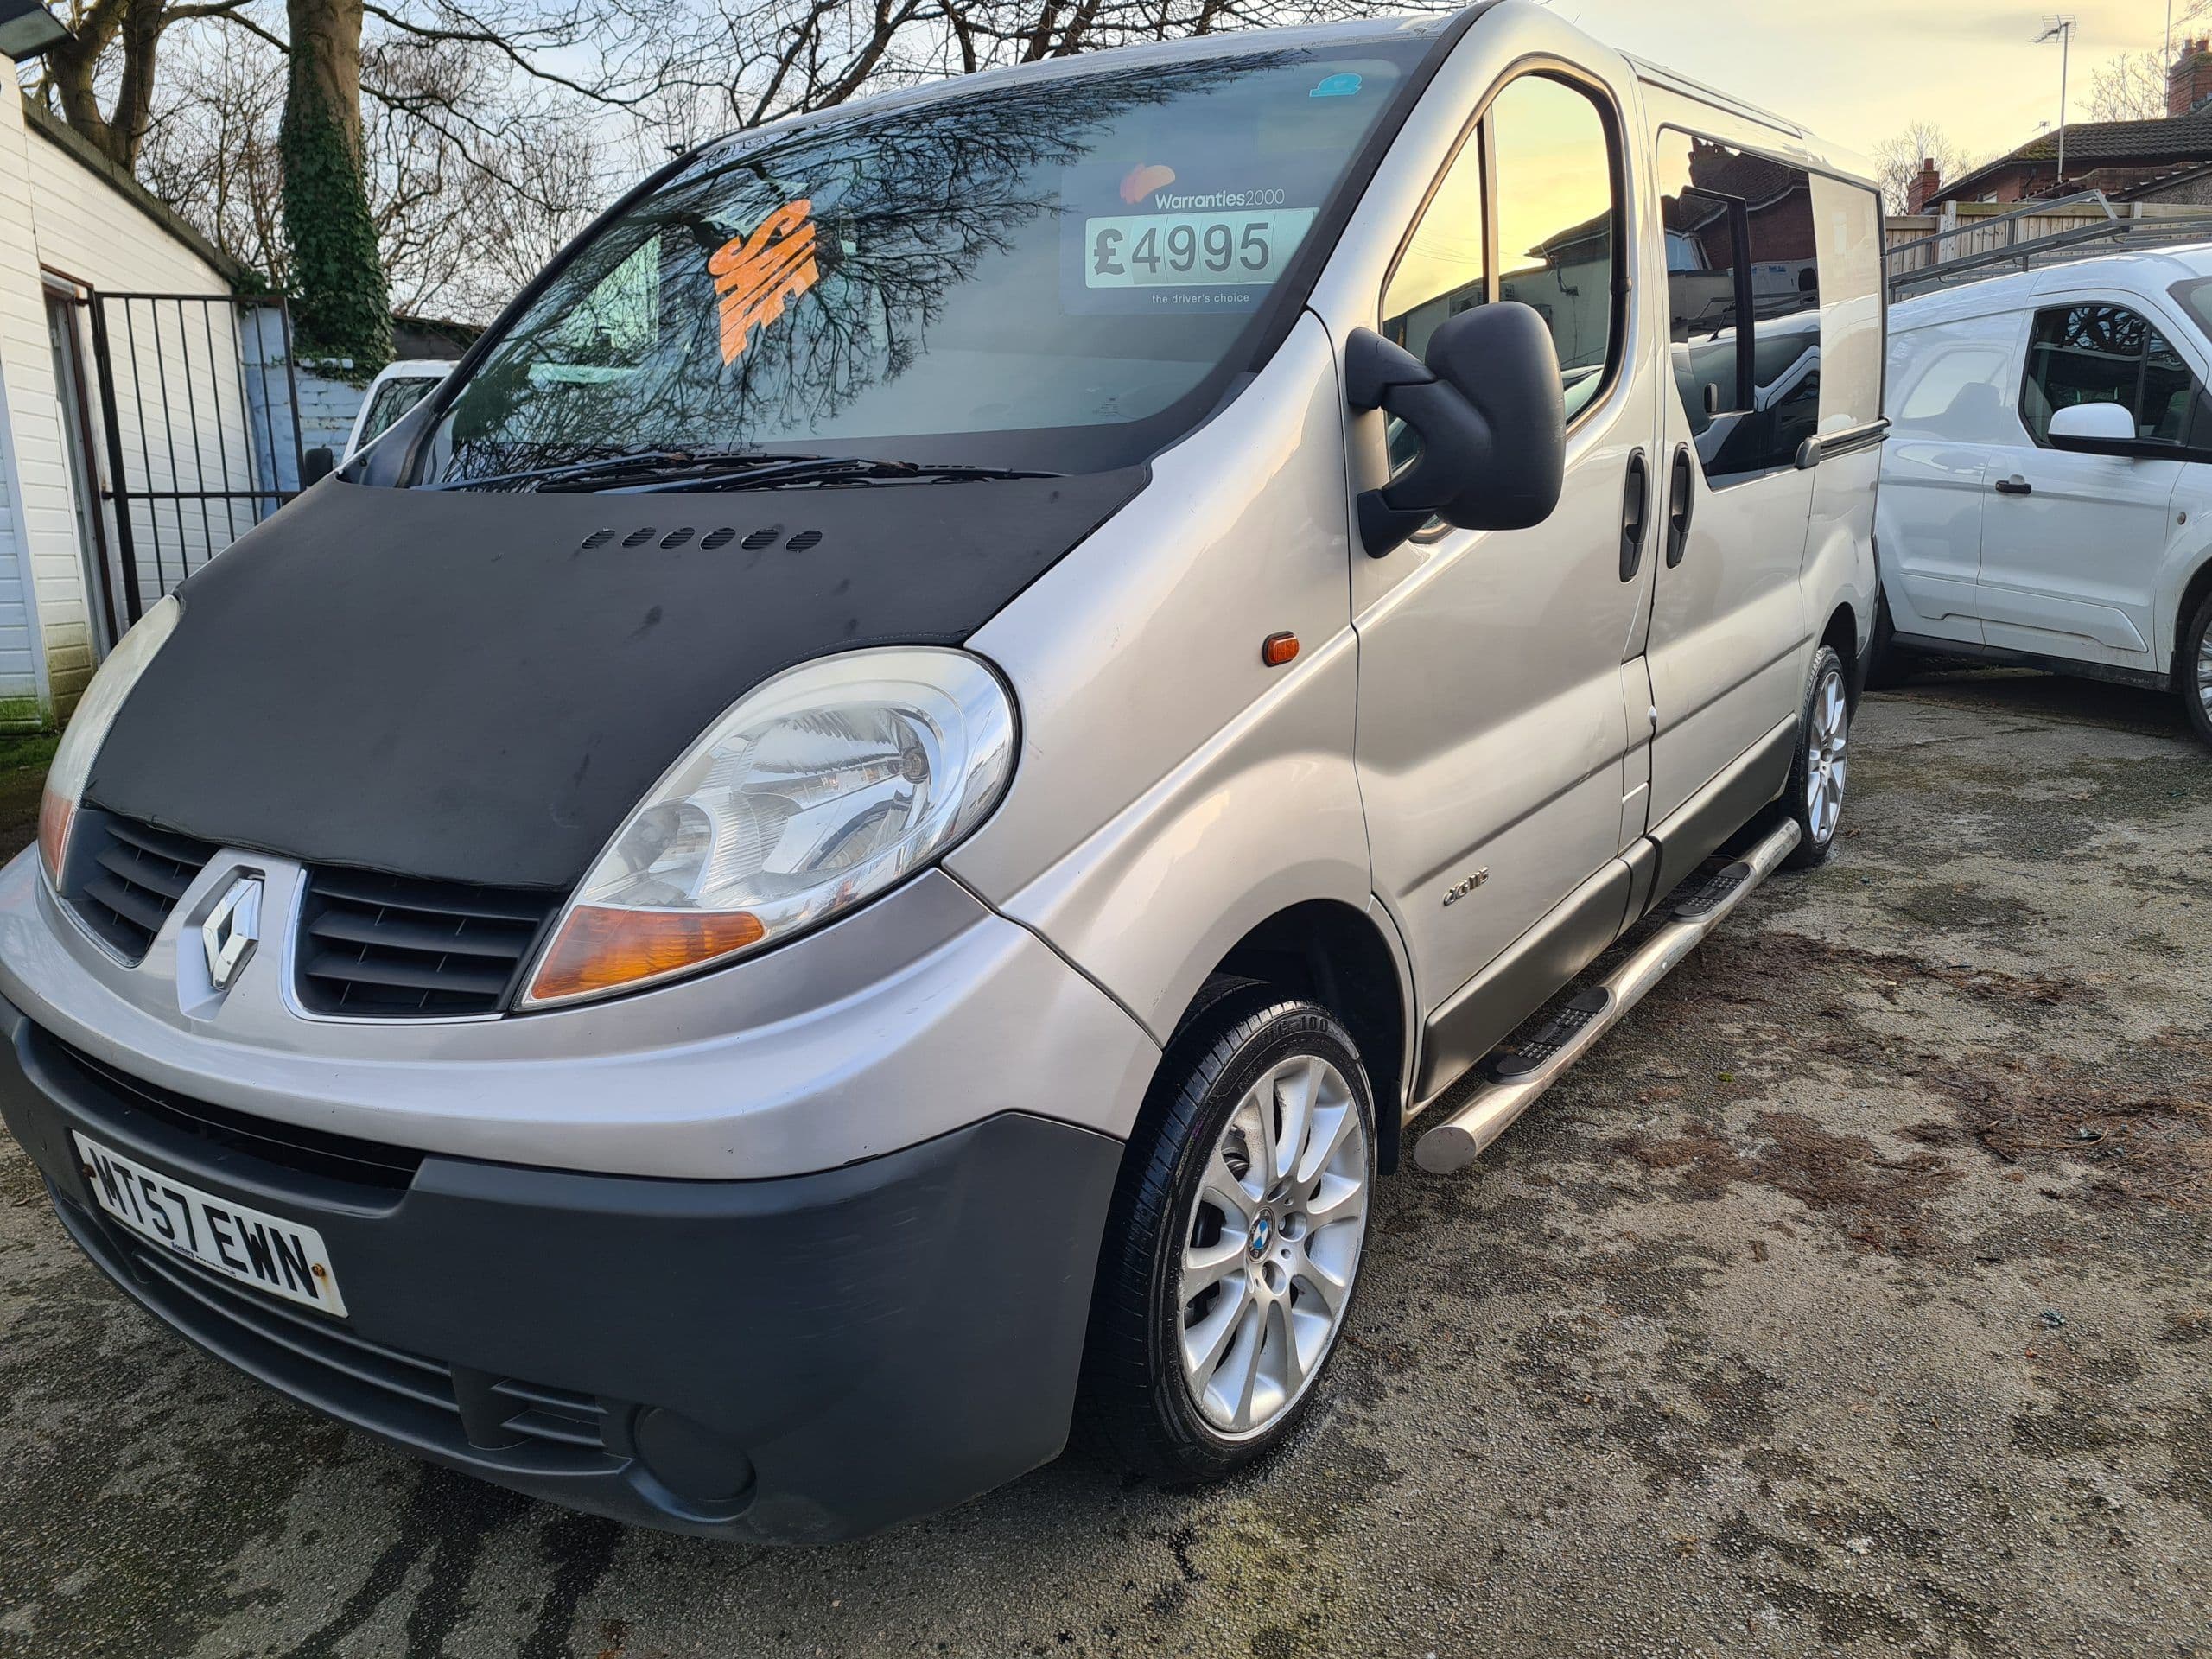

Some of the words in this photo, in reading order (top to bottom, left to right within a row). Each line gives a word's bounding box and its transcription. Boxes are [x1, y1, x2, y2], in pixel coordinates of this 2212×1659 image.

[708, 199, 819, 366] SALE
[1093, 222, 1270, 276] £4995
[1152, 295, 1168, 304] the
[1172, 293, 1210, 304] driver's
[1214, 292, 1249, 303] choice
[88, 1147, 199, 1253] MT57
[200, 1203, 320, 1300] EWN
